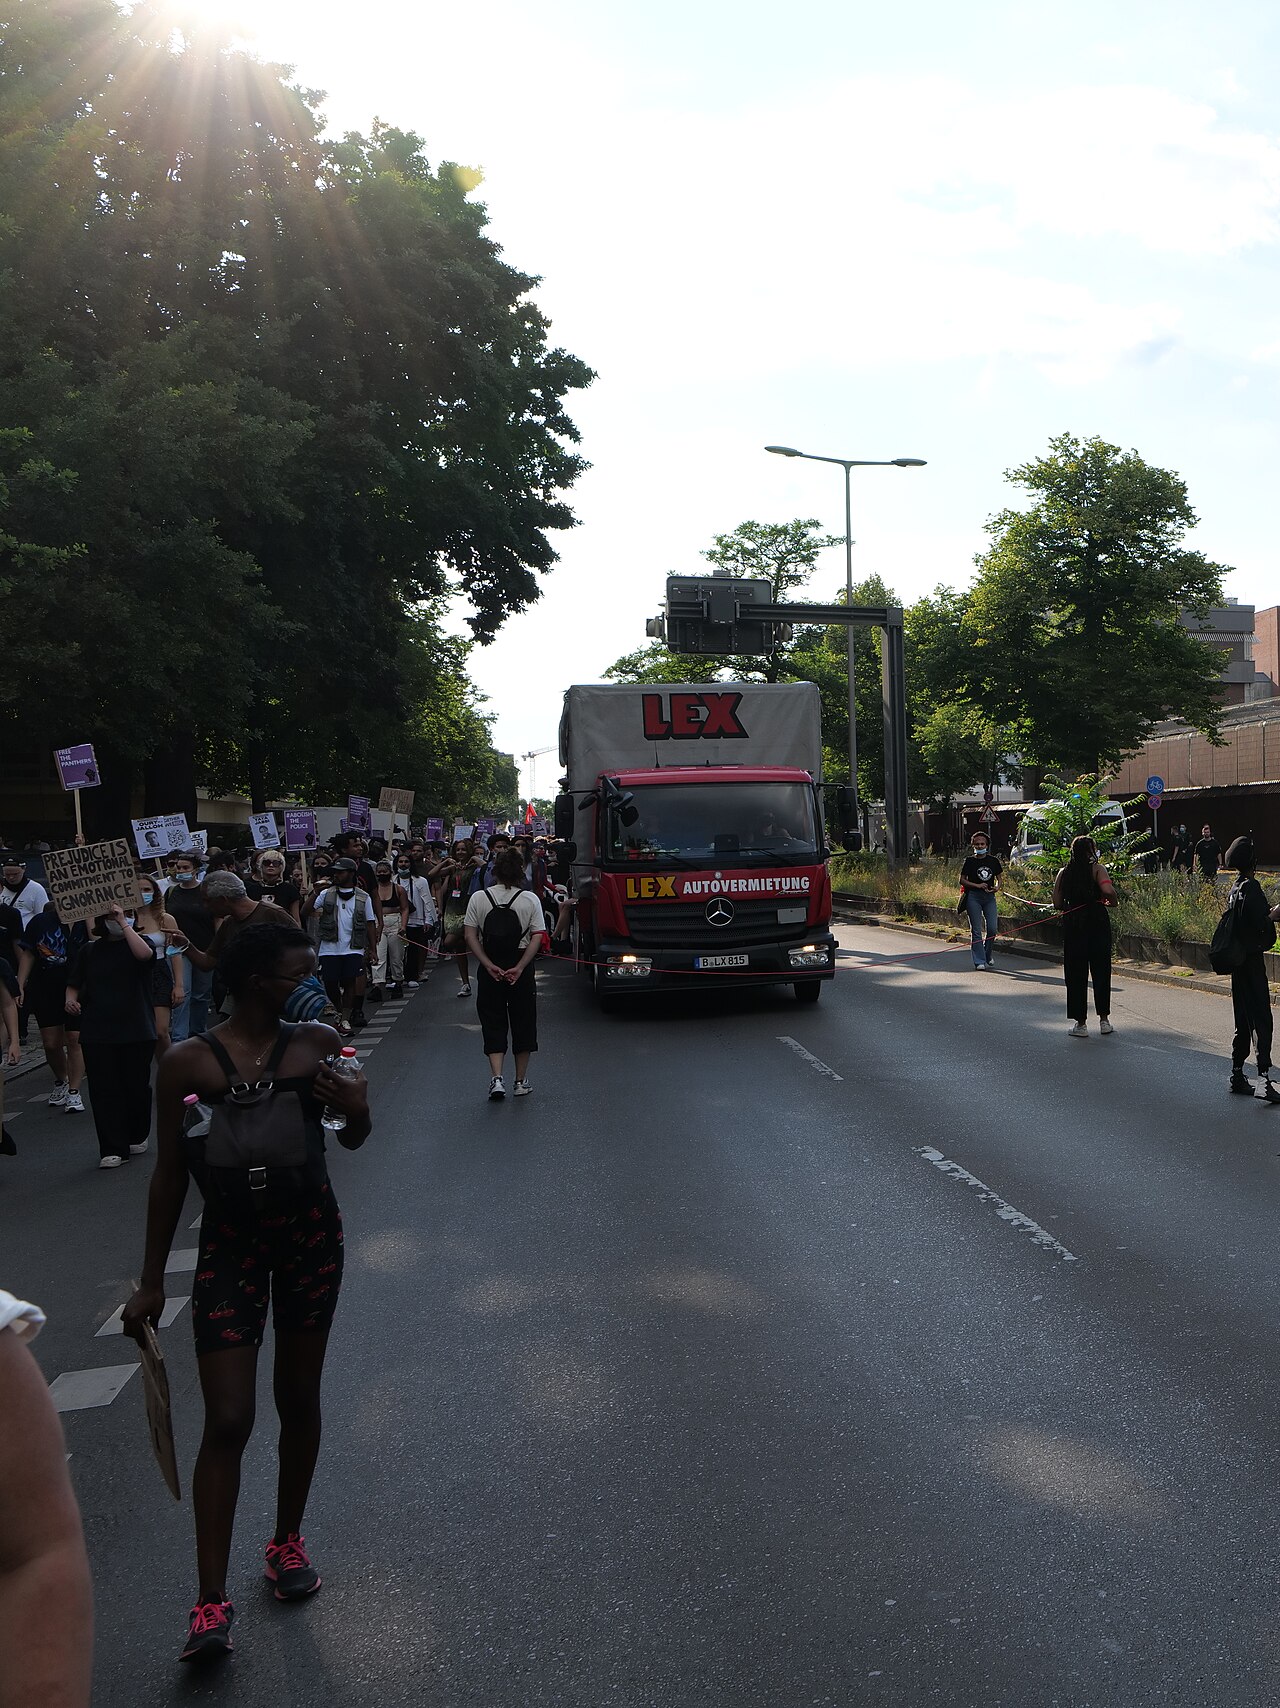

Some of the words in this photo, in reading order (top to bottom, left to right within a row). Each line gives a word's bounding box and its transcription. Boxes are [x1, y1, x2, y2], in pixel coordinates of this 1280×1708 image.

[642, 692, 749, 740] LEX
[61, 758, 92, 767] PANTHERS
[43, 844, 107, 870] PREJUDICE
[109, 841, 127, 857] IS
[50, 868, 69, 883] AN
[70, 856, 132, 876] EMOTIONAL
[51, 870, 117, 894] COMMITMENT
[119, 868, 133, 880] TO
[626, 875, 679, 900] LEX
[683, 876, 810, 894] AUTOVERMIETUNG
[702, 956, 709, 966] B
[714, 955, 727, 966] LX
[729, 956, 745, 966] 815
